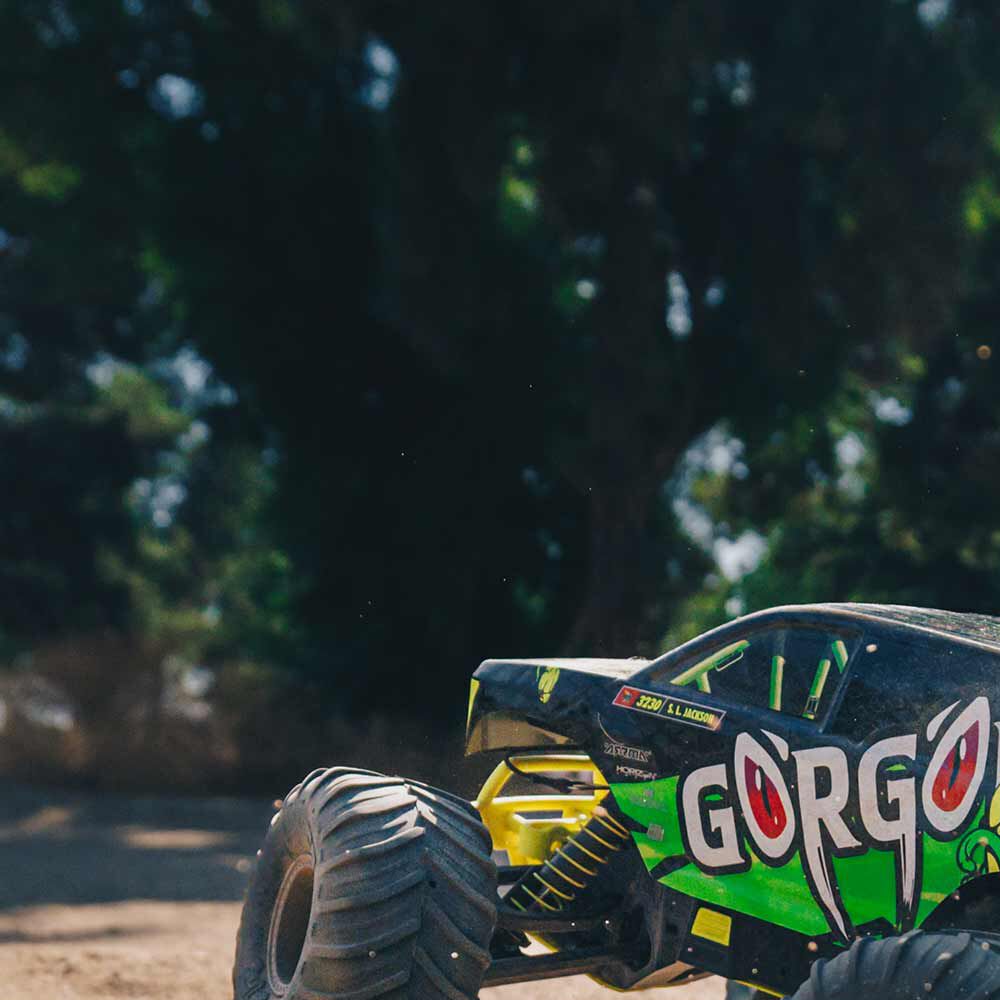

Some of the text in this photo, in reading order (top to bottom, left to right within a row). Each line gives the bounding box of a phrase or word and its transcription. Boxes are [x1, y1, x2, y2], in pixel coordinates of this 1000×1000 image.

[636, 695, 662, 711] 3230
[667, 703, 673, 714] S.
[683, 708, 715, 724] JACKSON
